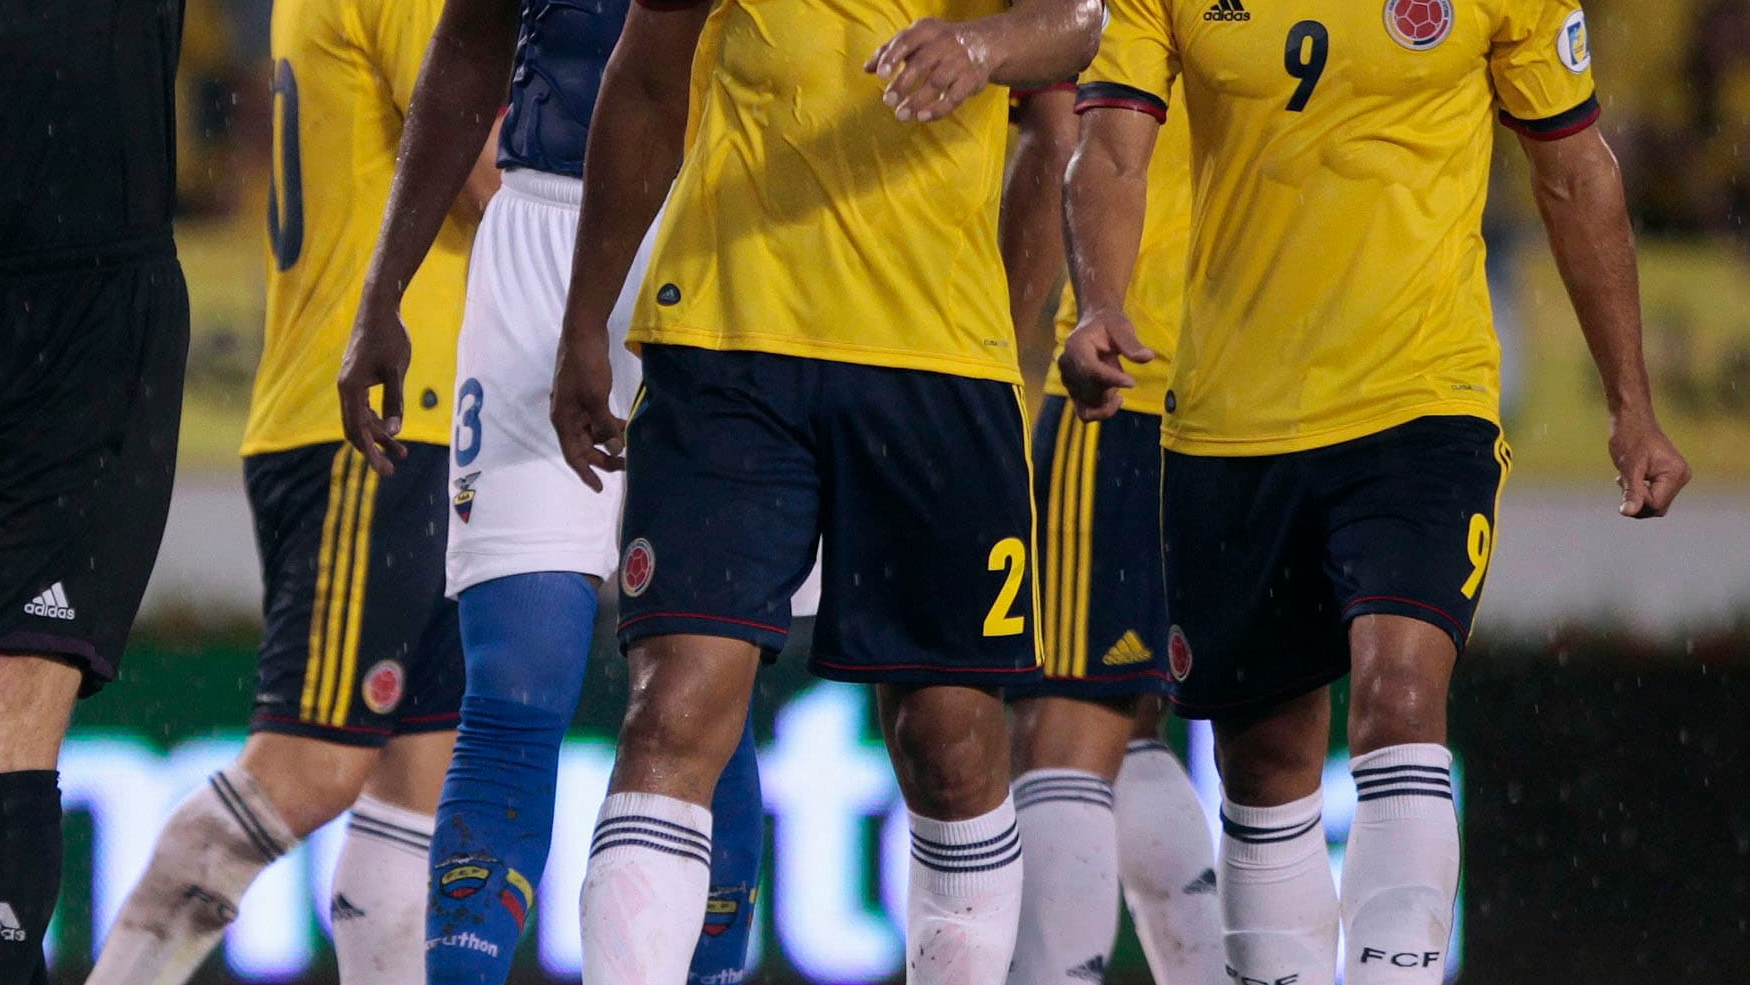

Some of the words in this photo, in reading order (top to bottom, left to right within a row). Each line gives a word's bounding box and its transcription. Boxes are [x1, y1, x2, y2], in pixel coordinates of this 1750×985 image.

[1203, 9, 1251, 22] adidas
[1284, 20, 1329, 112] 9
[455, 377, 484, 467] 3
[983, 537, 1026, 637] 2
[1460, 513, 1491, 600] 9
[24, 602, 75, 620] adidas
[1361, 947, 1440, 968] FCF
